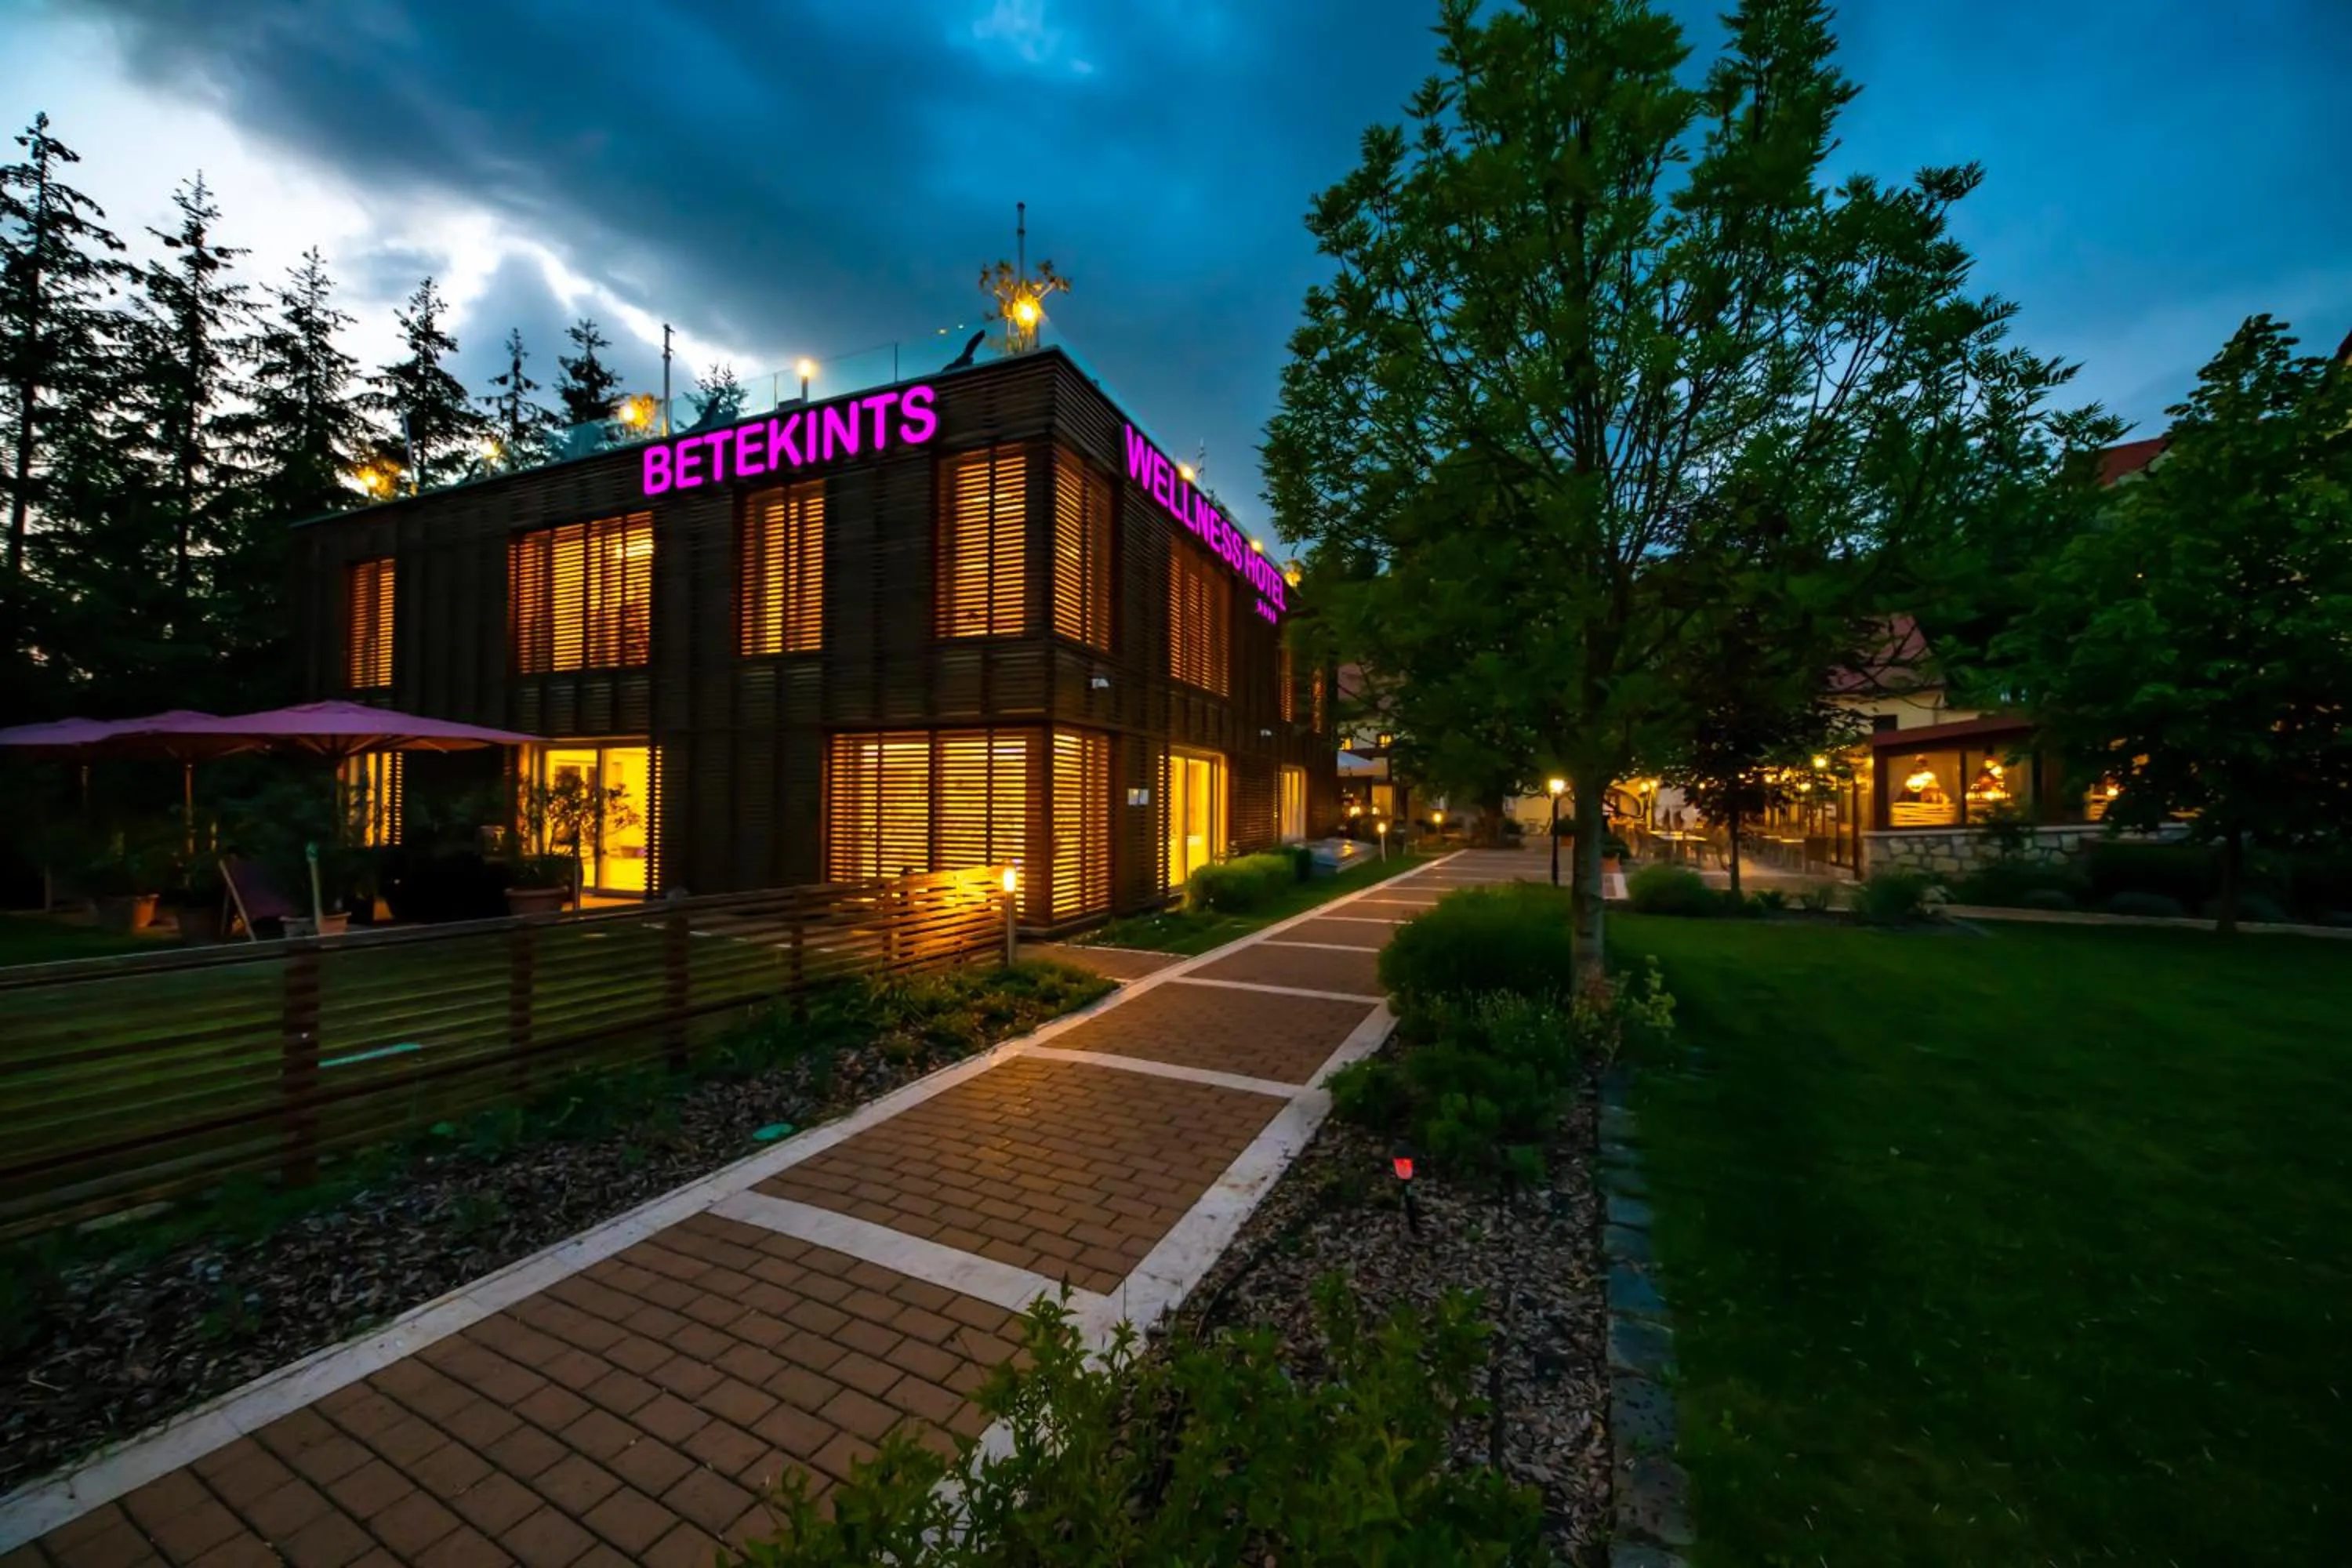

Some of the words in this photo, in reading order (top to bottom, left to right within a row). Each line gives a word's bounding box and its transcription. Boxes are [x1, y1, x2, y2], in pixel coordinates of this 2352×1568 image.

[643, 384, 938, 496] BETEKINTS
[1125, 423, 1243, 571] WELLNESS
[1244, 543, 1287, 612] HOTEL
